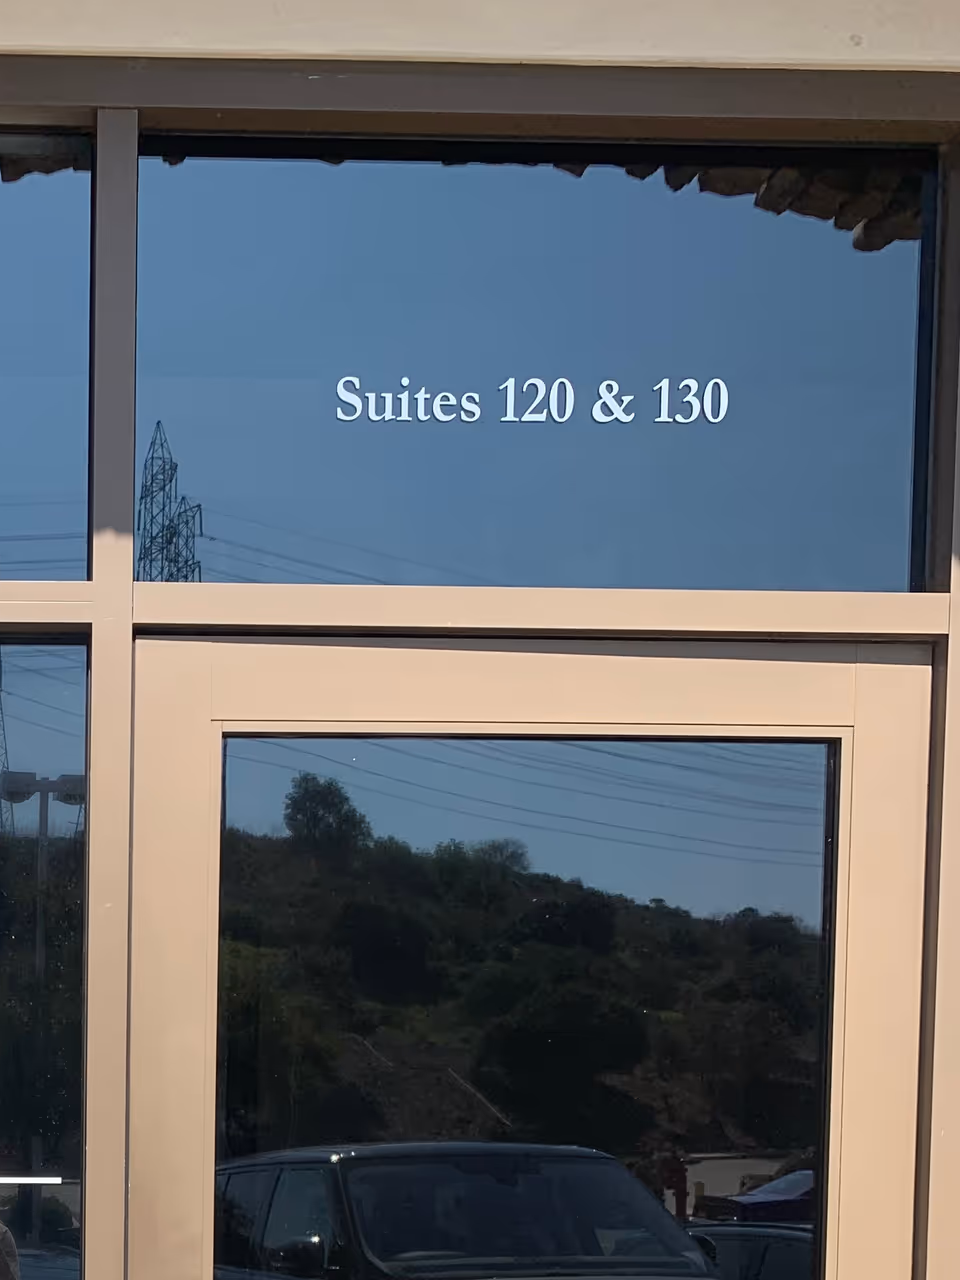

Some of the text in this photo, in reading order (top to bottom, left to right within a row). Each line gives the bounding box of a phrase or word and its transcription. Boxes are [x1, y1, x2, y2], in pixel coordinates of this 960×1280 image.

[336, 376, 730, 424] Suites 120 & 130
